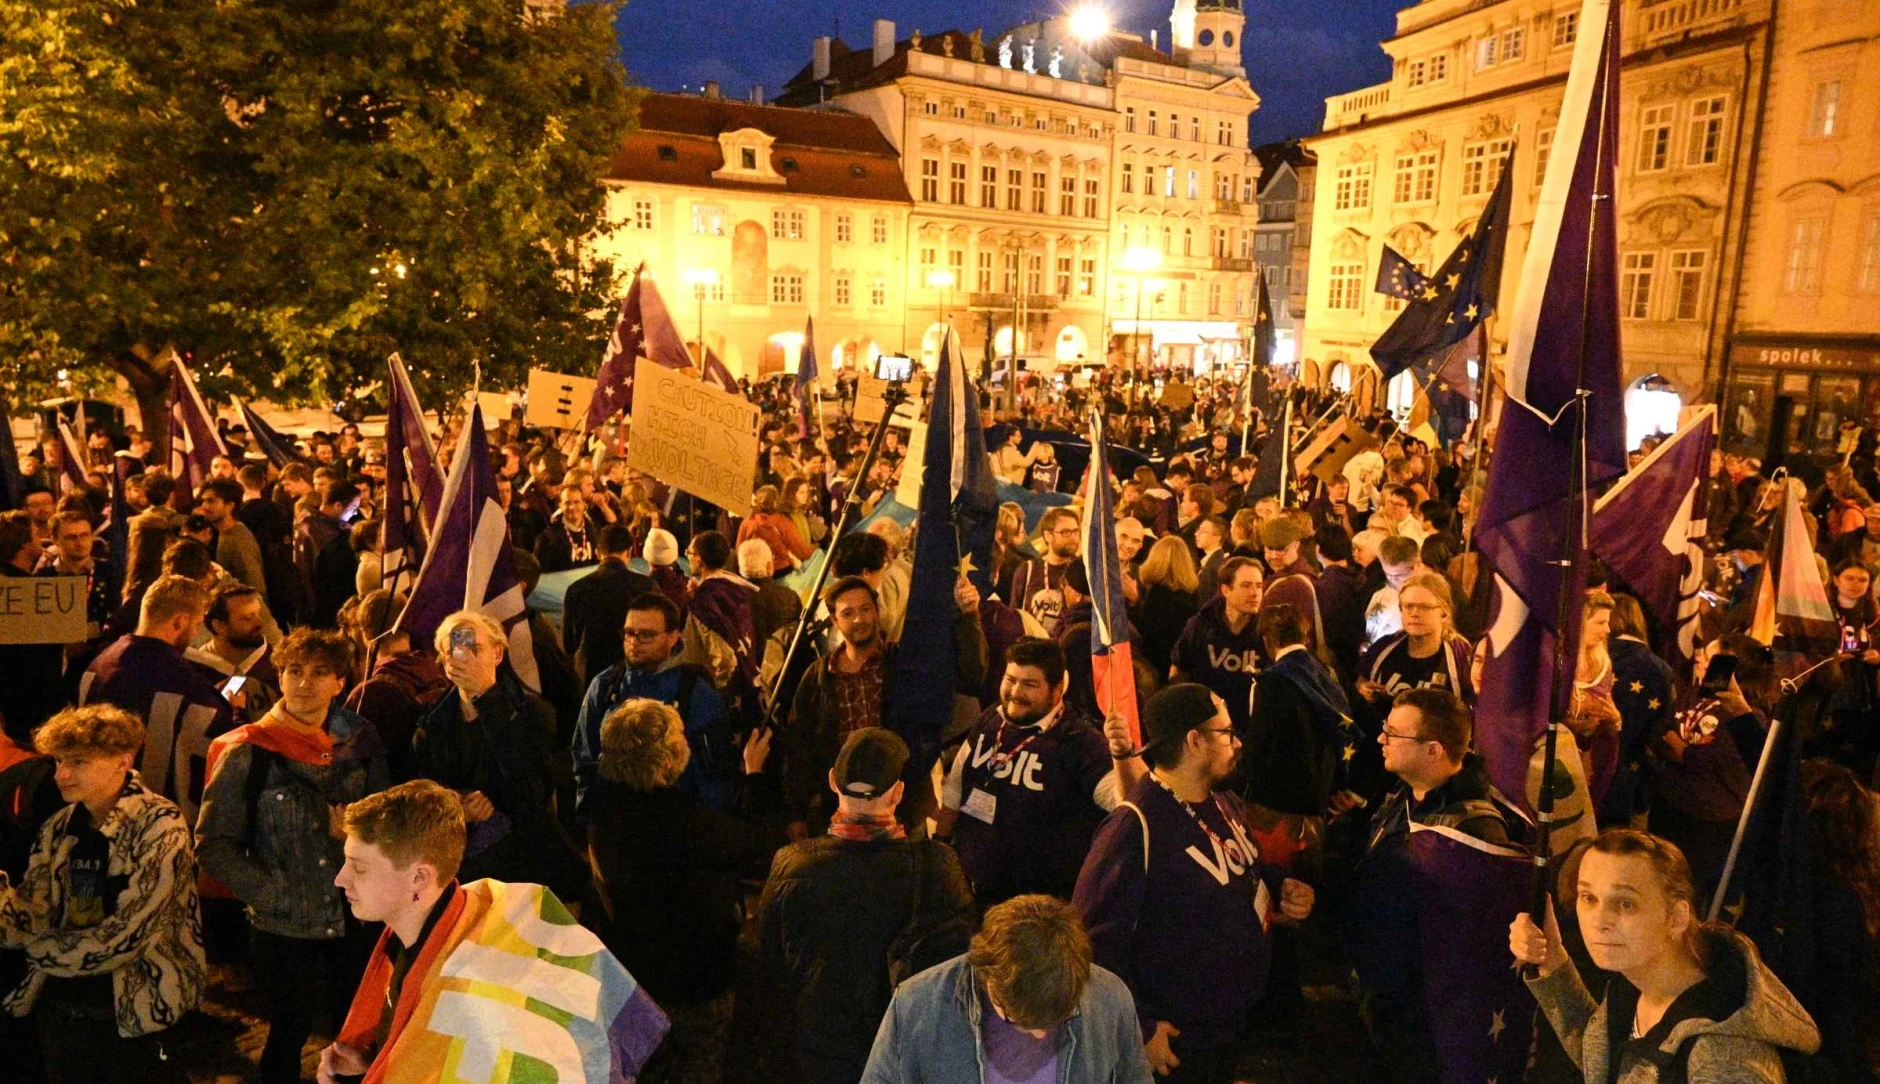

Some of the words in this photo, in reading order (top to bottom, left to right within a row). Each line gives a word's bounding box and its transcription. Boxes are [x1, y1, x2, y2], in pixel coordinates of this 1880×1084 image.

[647, 405, 707, 450] HIGH
[650, 437, 747, 505] VOLTAGE
[35, 582, 75, 615] EU
[1034, 599, 1060, 612] Volt
[1207, 643, 1262, 674] Volt
[971, 733, 1044, 791] Volt
[1185, 818, 1259, 886] Volt
